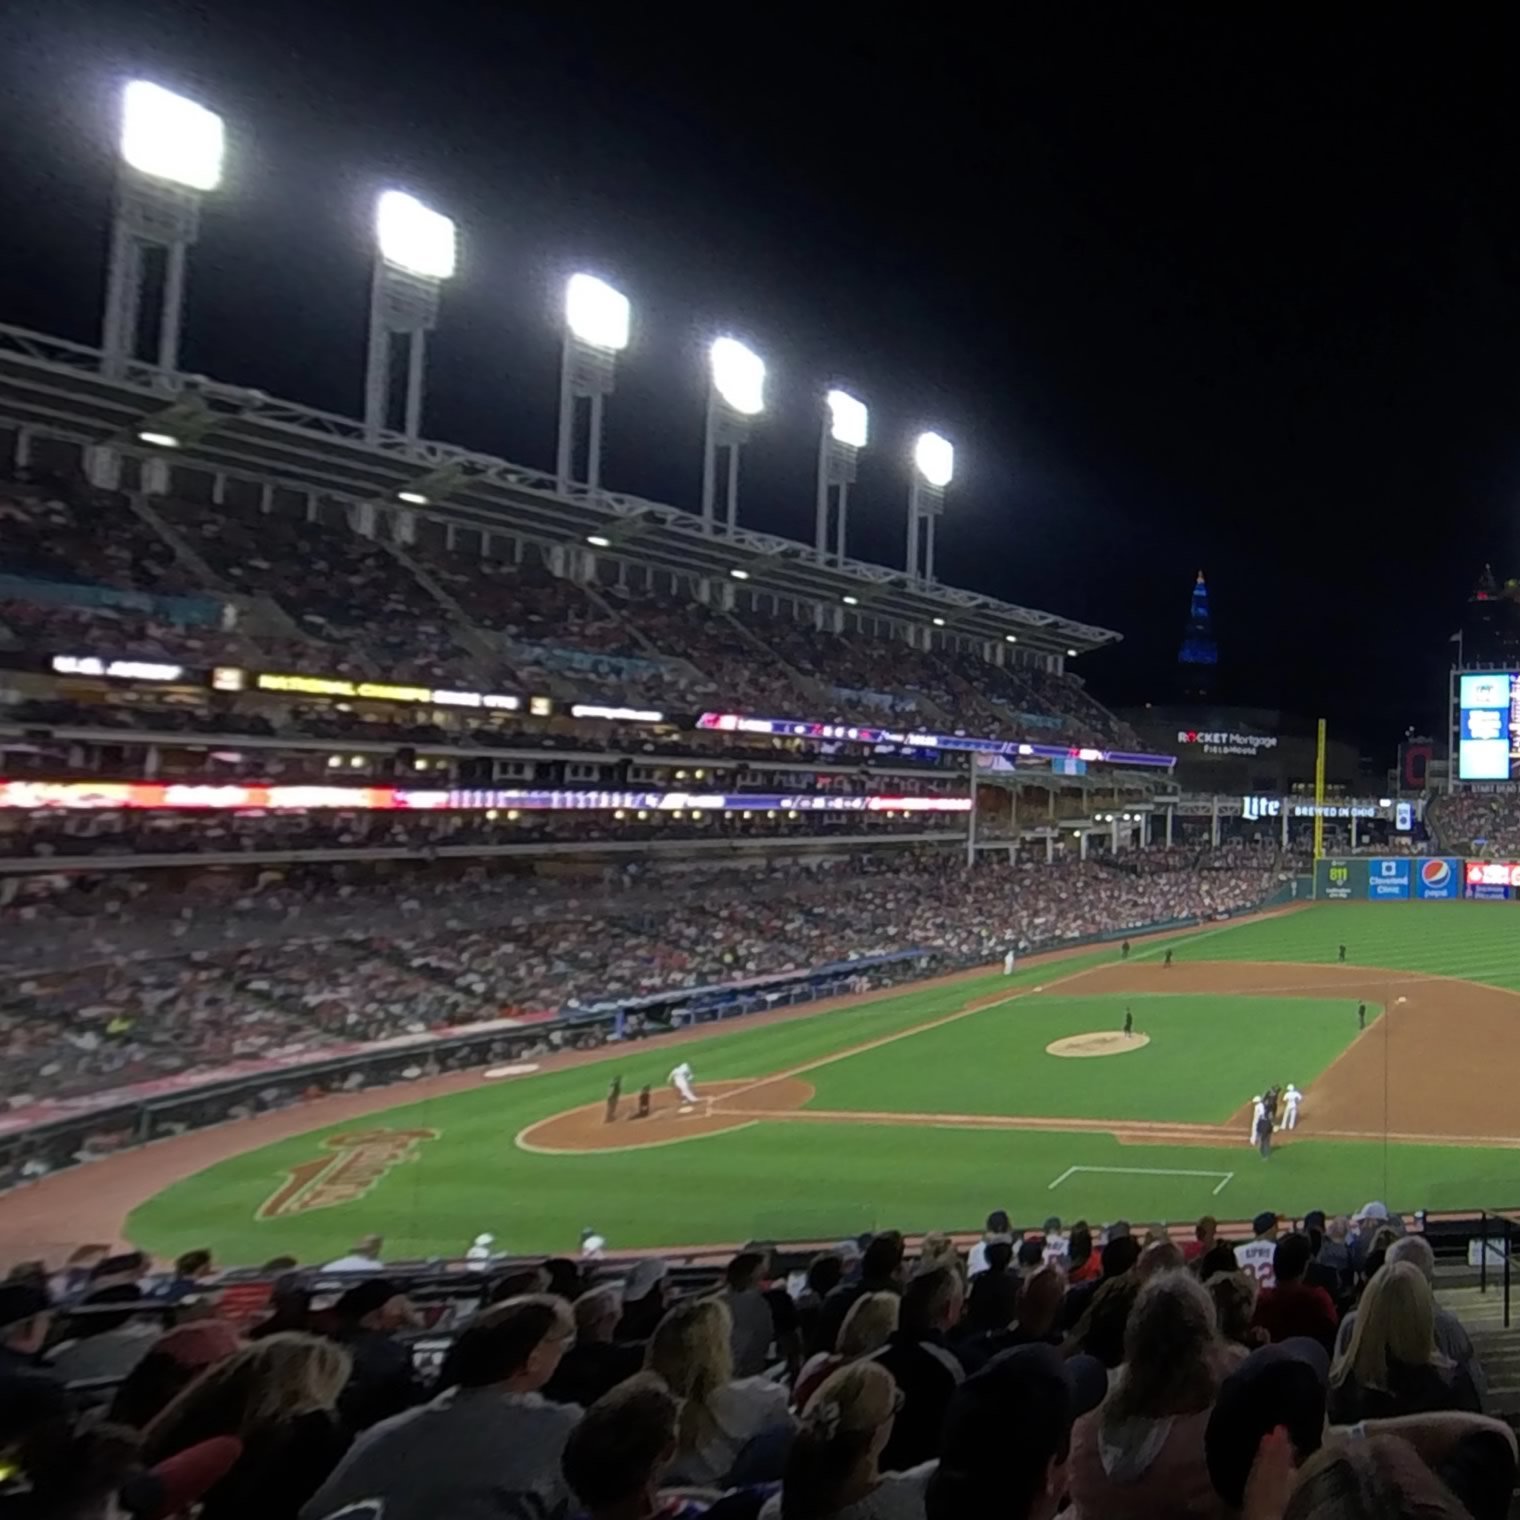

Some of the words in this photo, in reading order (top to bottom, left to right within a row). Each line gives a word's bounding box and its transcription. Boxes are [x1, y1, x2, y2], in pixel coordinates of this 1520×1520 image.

[1178, 731, 1228, 743] ROCKET
[1229, 733, 1277, 748] Mortgage
[1203, 744, 1257, 755] FIELDHOUSE
[1242, 796, 1280, 820] Lite
[1295, 805, 1337, 817] BREWED
[1338, 806, 1349, 817] IN
[1351, 806, 1375, 817] OHIO
[1369, 876, 1409, 886] Cleveland
[1377, 885, 1400, 894] Clinic
[1424, 888, 1449, 898] pepsi
